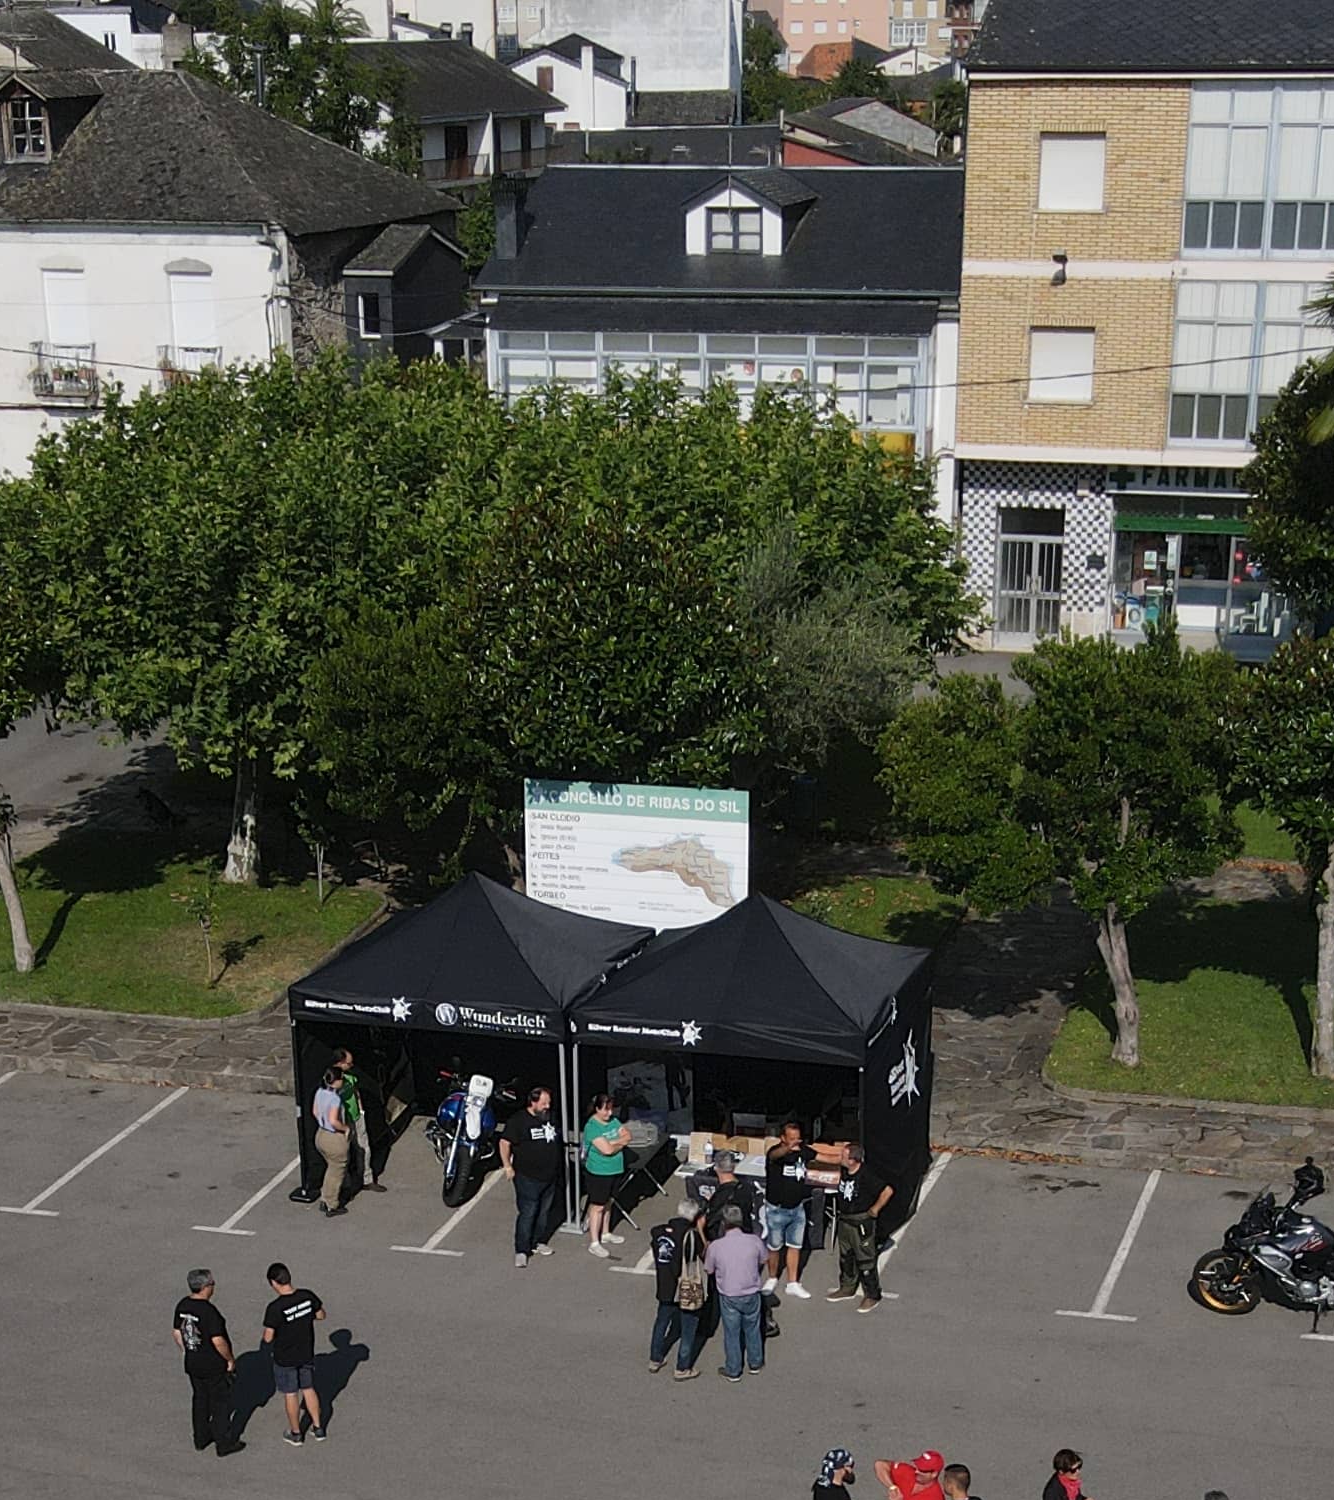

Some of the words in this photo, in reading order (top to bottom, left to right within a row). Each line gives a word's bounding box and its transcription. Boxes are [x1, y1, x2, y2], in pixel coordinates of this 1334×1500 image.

[627, 795, 645, 807] DE
[649, 796, 691, 810] RIBAS
[694, 799, 715, 812] DO
[719, 800, 740, 813] SIL
[531, 812, 547, 821] SAN
[459, 1006, 547, 1029] Wunderlich
